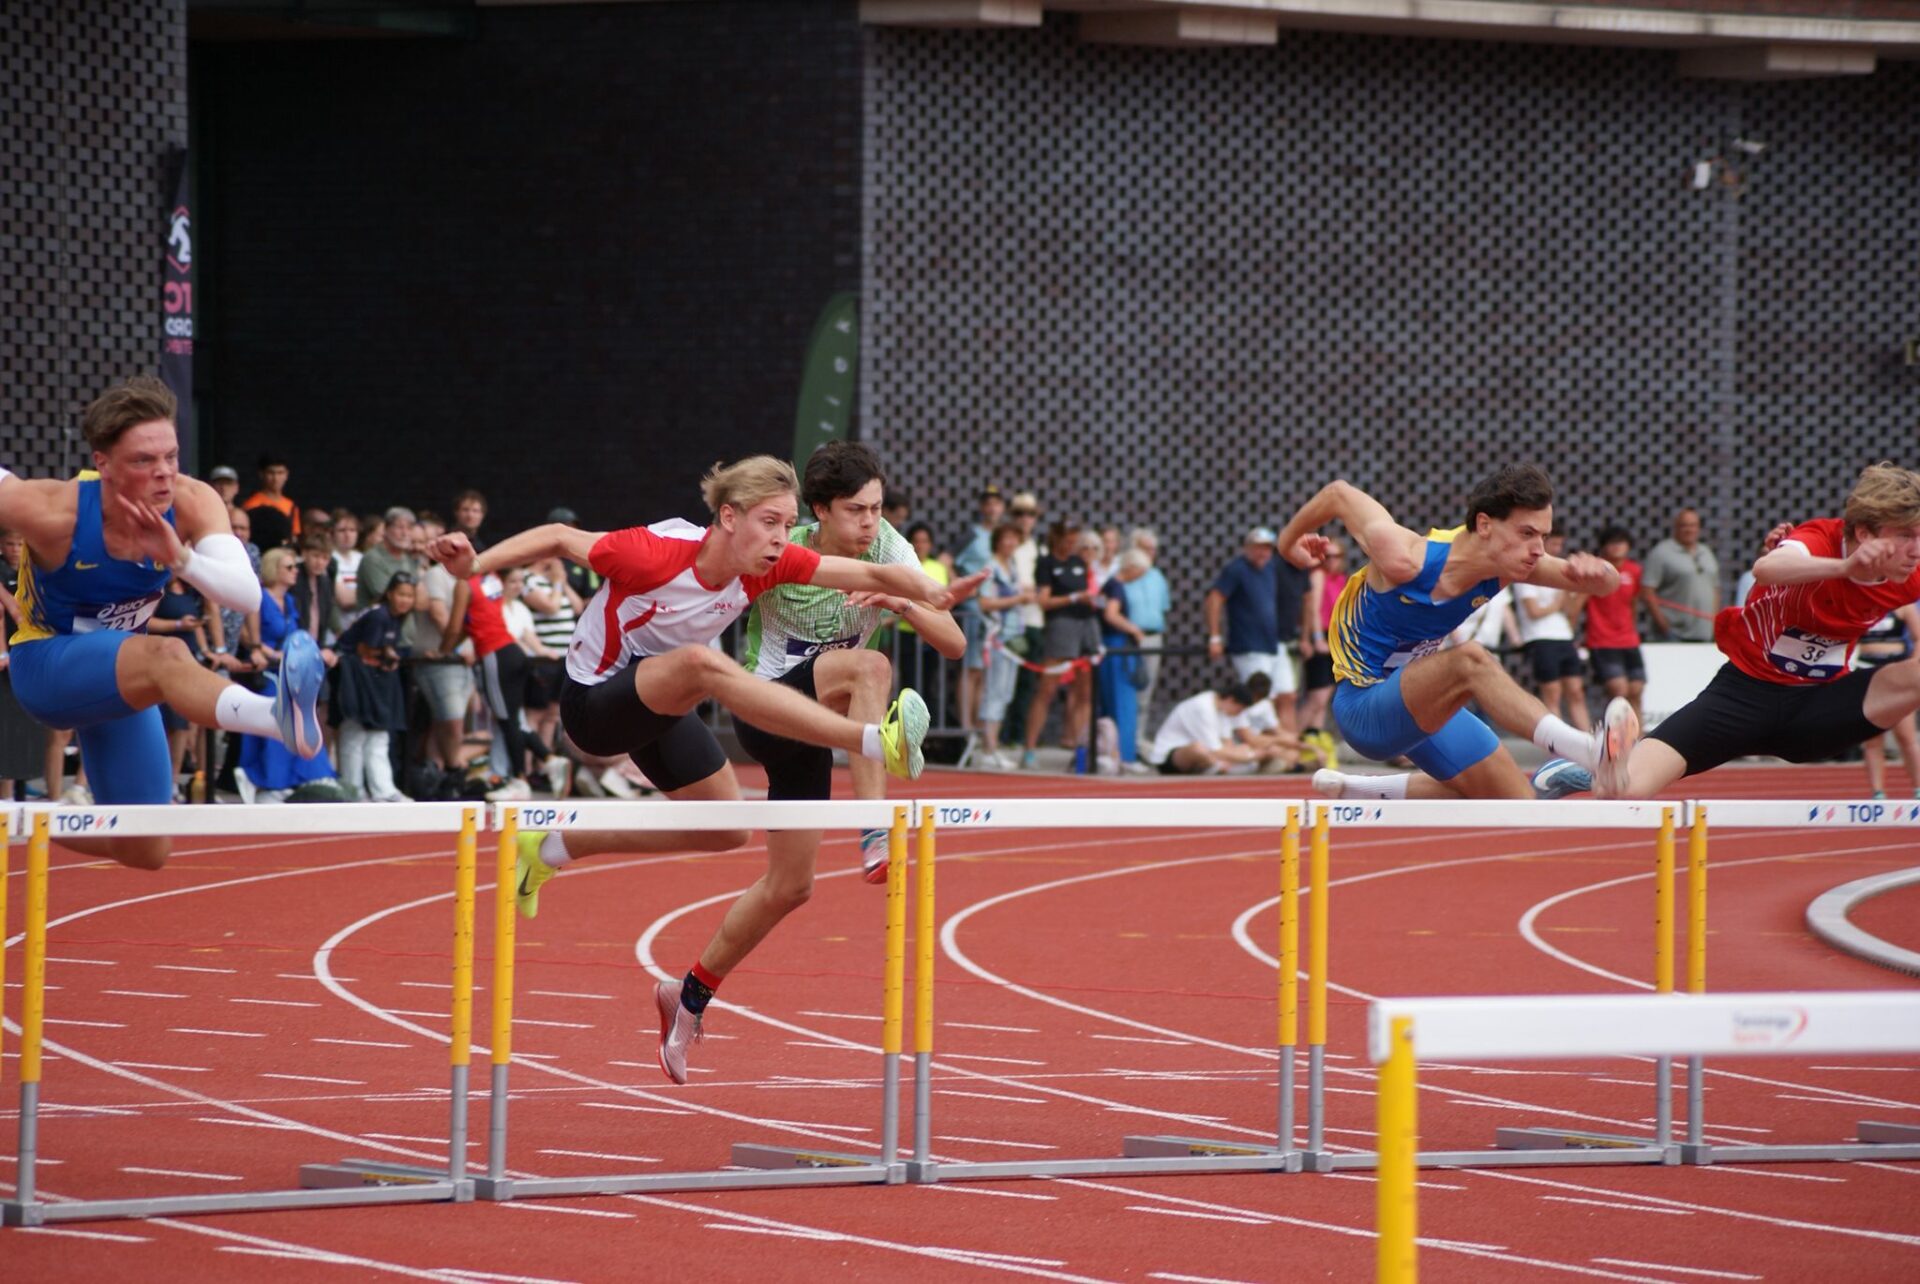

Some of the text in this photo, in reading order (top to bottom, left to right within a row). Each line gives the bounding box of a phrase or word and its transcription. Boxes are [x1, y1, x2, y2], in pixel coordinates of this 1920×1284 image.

[523, 809, 556, 825] TOP
[940, 808, 971, 823] TOP
[1333, 806, 1363, 821] TOP
[1847, 804, 1884, 822] TOP
[56, 814, 94, 831] TOP
